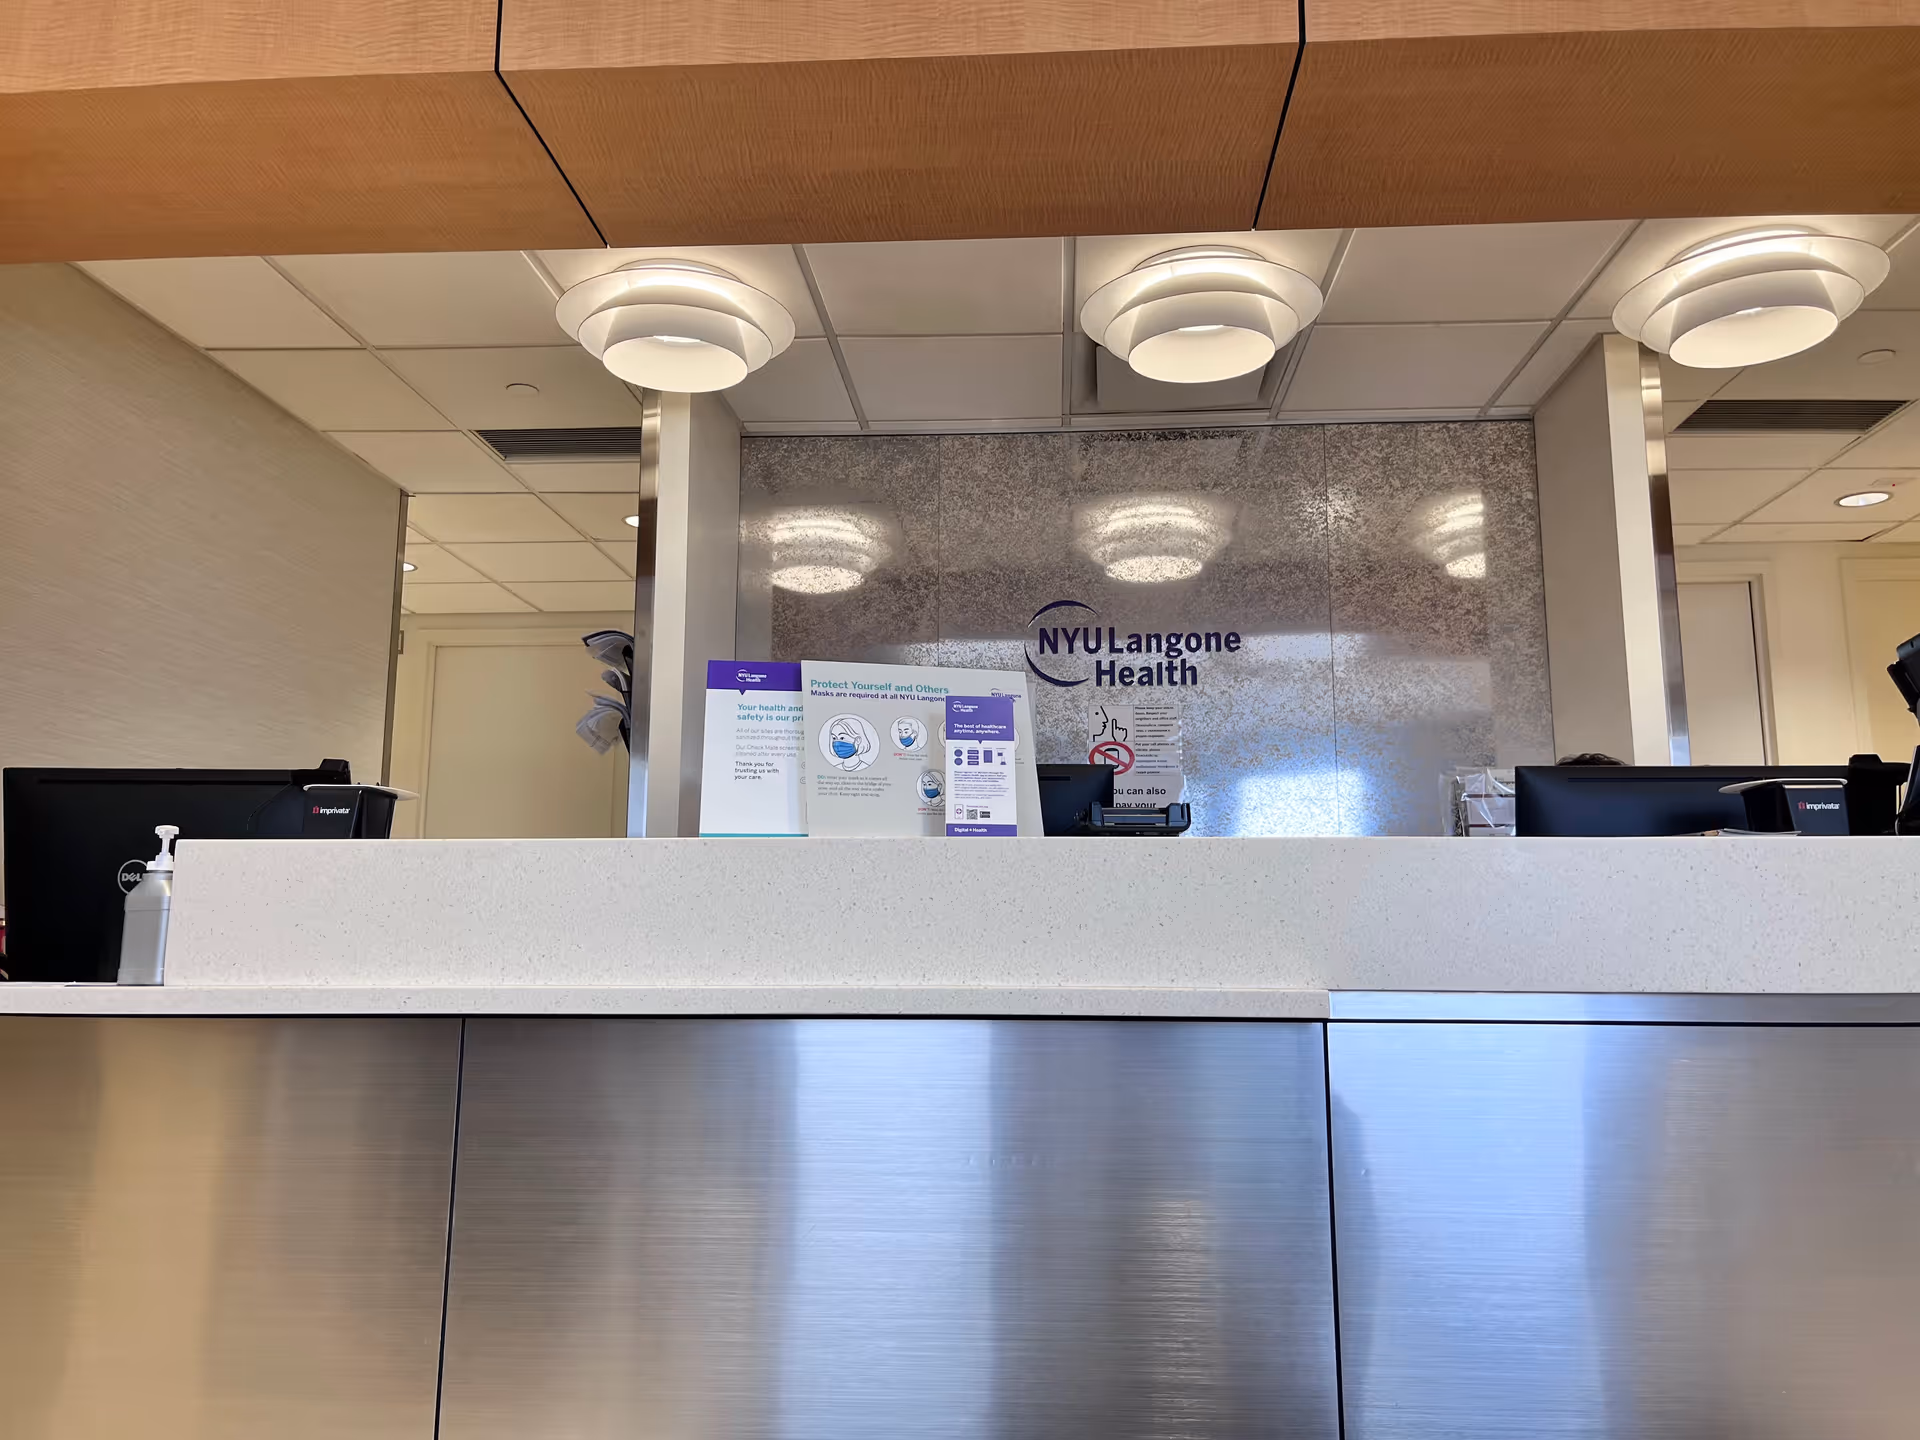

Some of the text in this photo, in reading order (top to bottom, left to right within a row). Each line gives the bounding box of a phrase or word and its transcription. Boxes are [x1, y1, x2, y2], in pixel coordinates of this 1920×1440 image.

[1039, 627, 1241, 659] NYU Langone
[1095, 658, 1198, 687] Health
[810, 679, 949, 694] Protect Yourself and Others
[849, 692, 879, 700] required
[737, 703, 804, 712] Your health and
[737, 713, 764, 722] safety
[766, 713, 774, 721] is
[792, 714, 804, 723] pri
[1146, 786, 1167, 795] also
[319, 806, 350, 816] imprivata
[1805, 801, 1840, 811] imprivata
[121, 872, 143, 882] DEL
